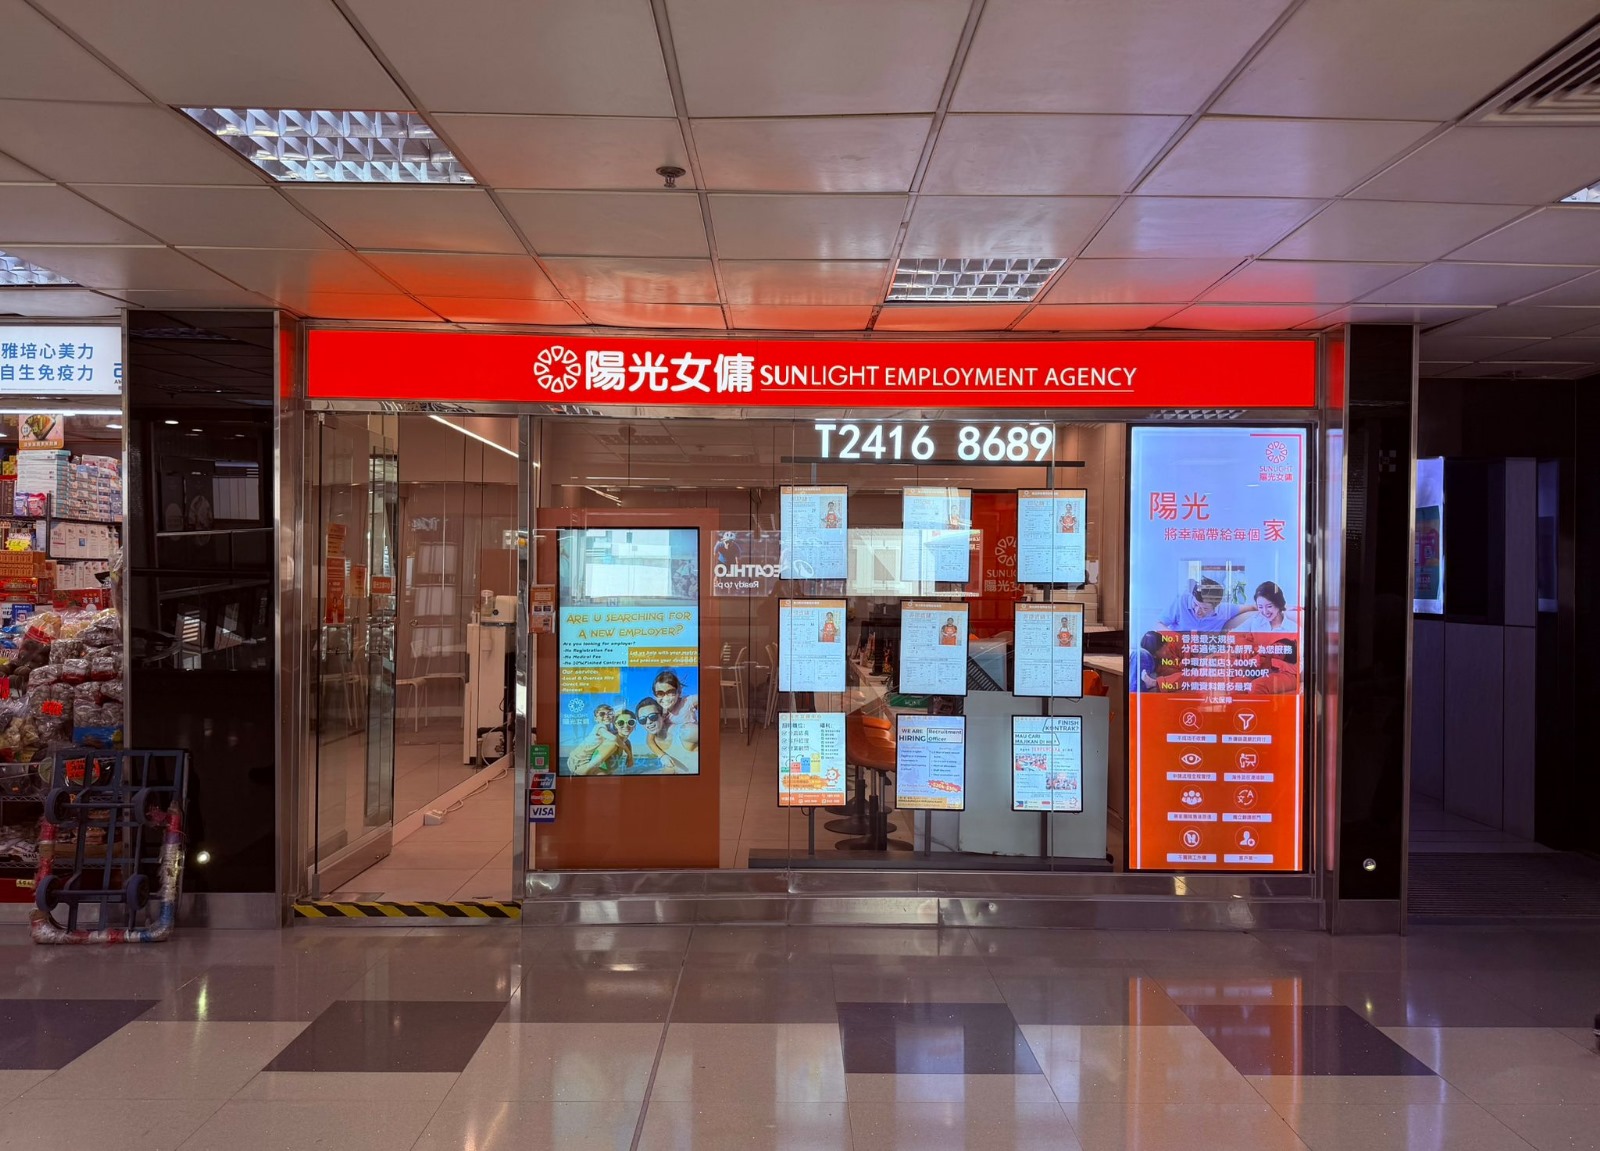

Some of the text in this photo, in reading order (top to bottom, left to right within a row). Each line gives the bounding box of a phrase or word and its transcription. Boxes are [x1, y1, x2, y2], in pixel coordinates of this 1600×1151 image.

[1, 342, 94, 360] 雅培心美力
[0, 364, 94, 381] 自生免疫力
[586, 351, 754, 393] 陽光女傭
[760, 365, 1136, 386] SUNLIGHT EMPLOYMENT AGENCY
[814, 423, 1054, 461] T2416 8689
[1149, 492, 1210, 521] 陽光
[1164, 519, 1286, 542] 將幸福帶給每個家
[567, 611, 692, 624] ARE U SEARCHING FOR
[578, 624, 685, 639] A NEW EMPLOYER?
[1161, 634, 1236, 644] No.1 香港最大規模
[1161, 658, 1179, 666] No.1
[1161, 682, 1179, 690] No.1
[532, 807, 554, 816] VISA
